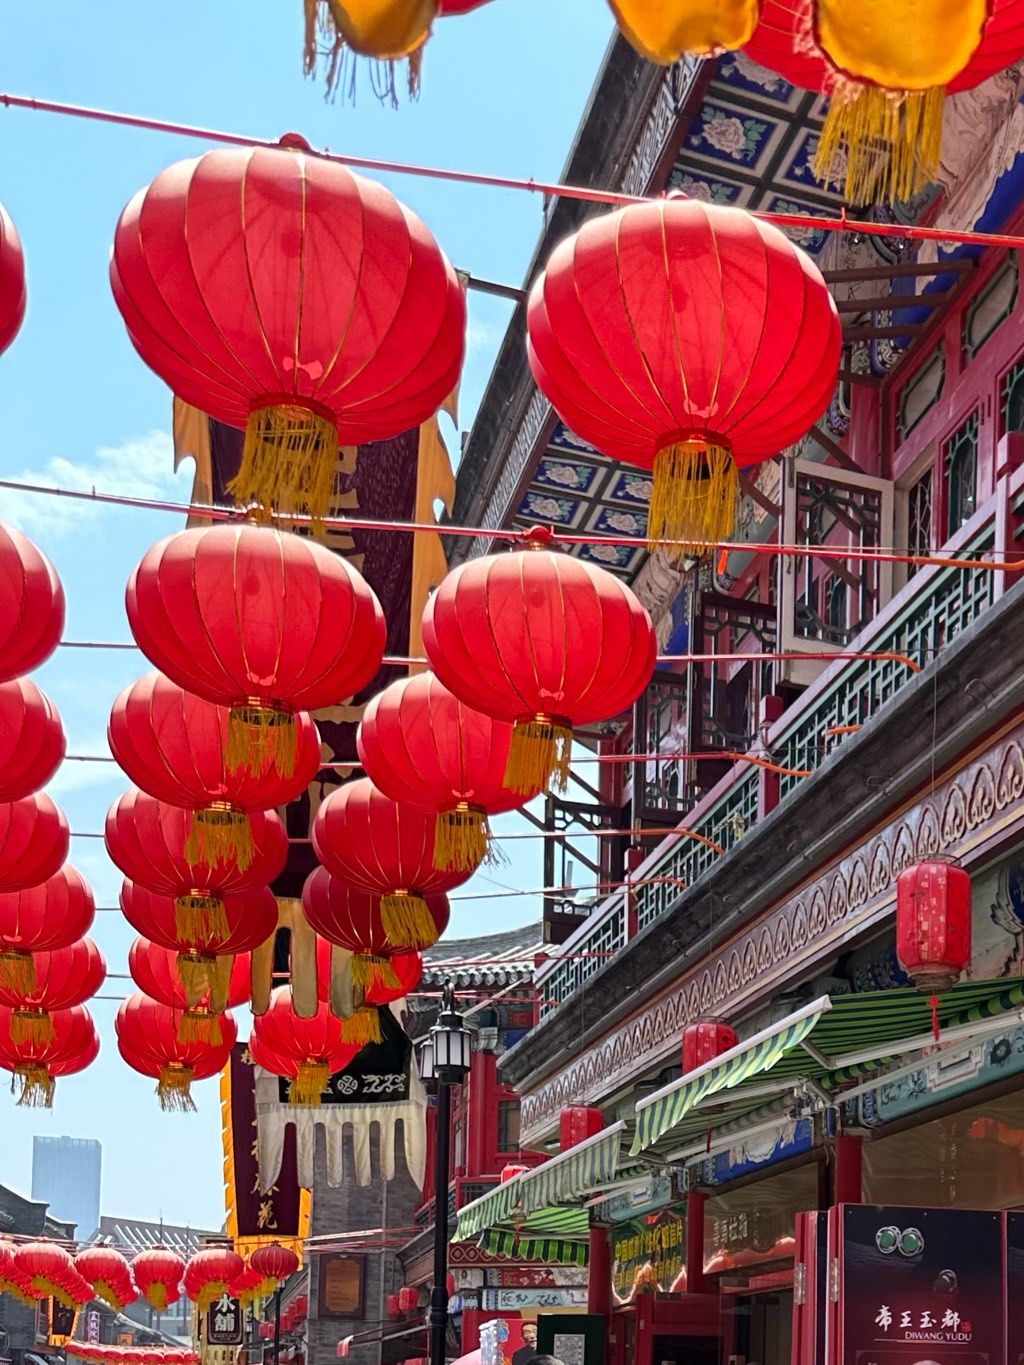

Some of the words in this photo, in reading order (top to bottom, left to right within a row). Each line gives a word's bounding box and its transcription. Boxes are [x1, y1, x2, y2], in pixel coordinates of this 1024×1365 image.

[874, 1304, 961, 1332] 帝王玉都
[905, 1331, 944, 1341] DIWANG
[945, 1333, 972, 1342] YUDU
